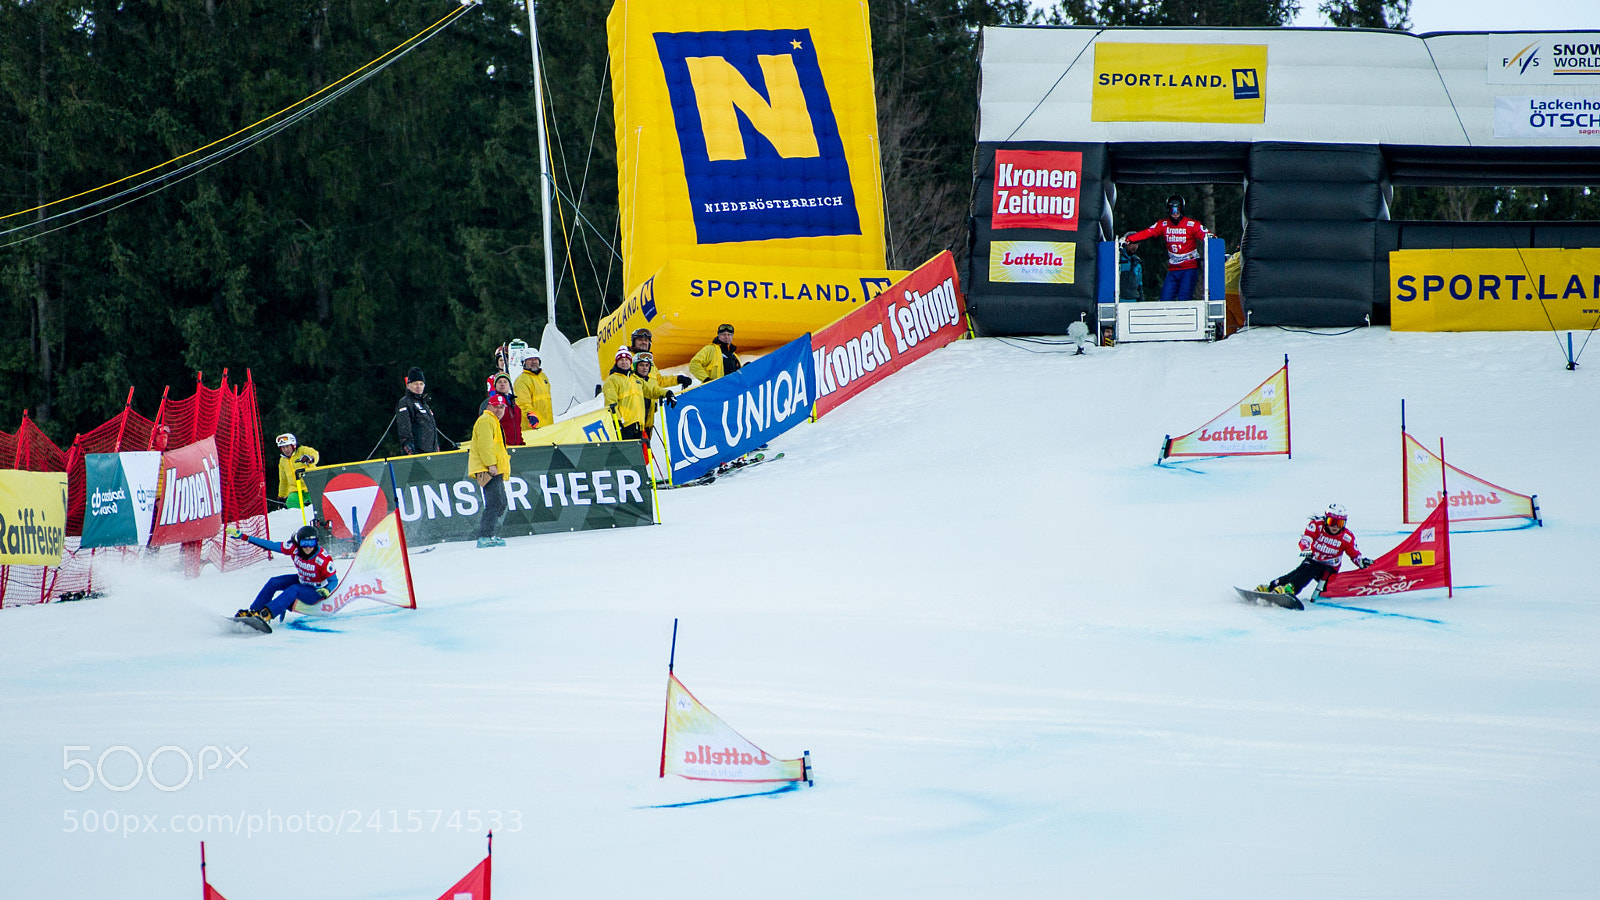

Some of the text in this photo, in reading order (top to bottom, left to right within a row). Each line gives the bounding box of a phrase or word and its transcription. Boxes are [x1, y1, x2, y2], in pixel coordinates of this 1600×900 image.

[1098, 73, 1227, 88] SPORT.LAND.
[685, 54, 820, 162] N
[998, 163, 1077, 189] Kronen
[704, 196, 843, 213] NIEDERÖSTERREICH
[997, 189, 1075, 219] Zeitung
[1002, 252, 1063, 267] Lattella
[690, 279, 857, 303] SPORT.LAND.
[812, 276, 960, 401] Kronen Zeitung
[721, 361, 808, 447] UNIQA
[1198, 425, 1268, 441] Lattella
[160, 467, 212, 526] Kronen
[396, 469, 644, 521] UNSR HEER
[1348, 579, 1424, 595] moser
